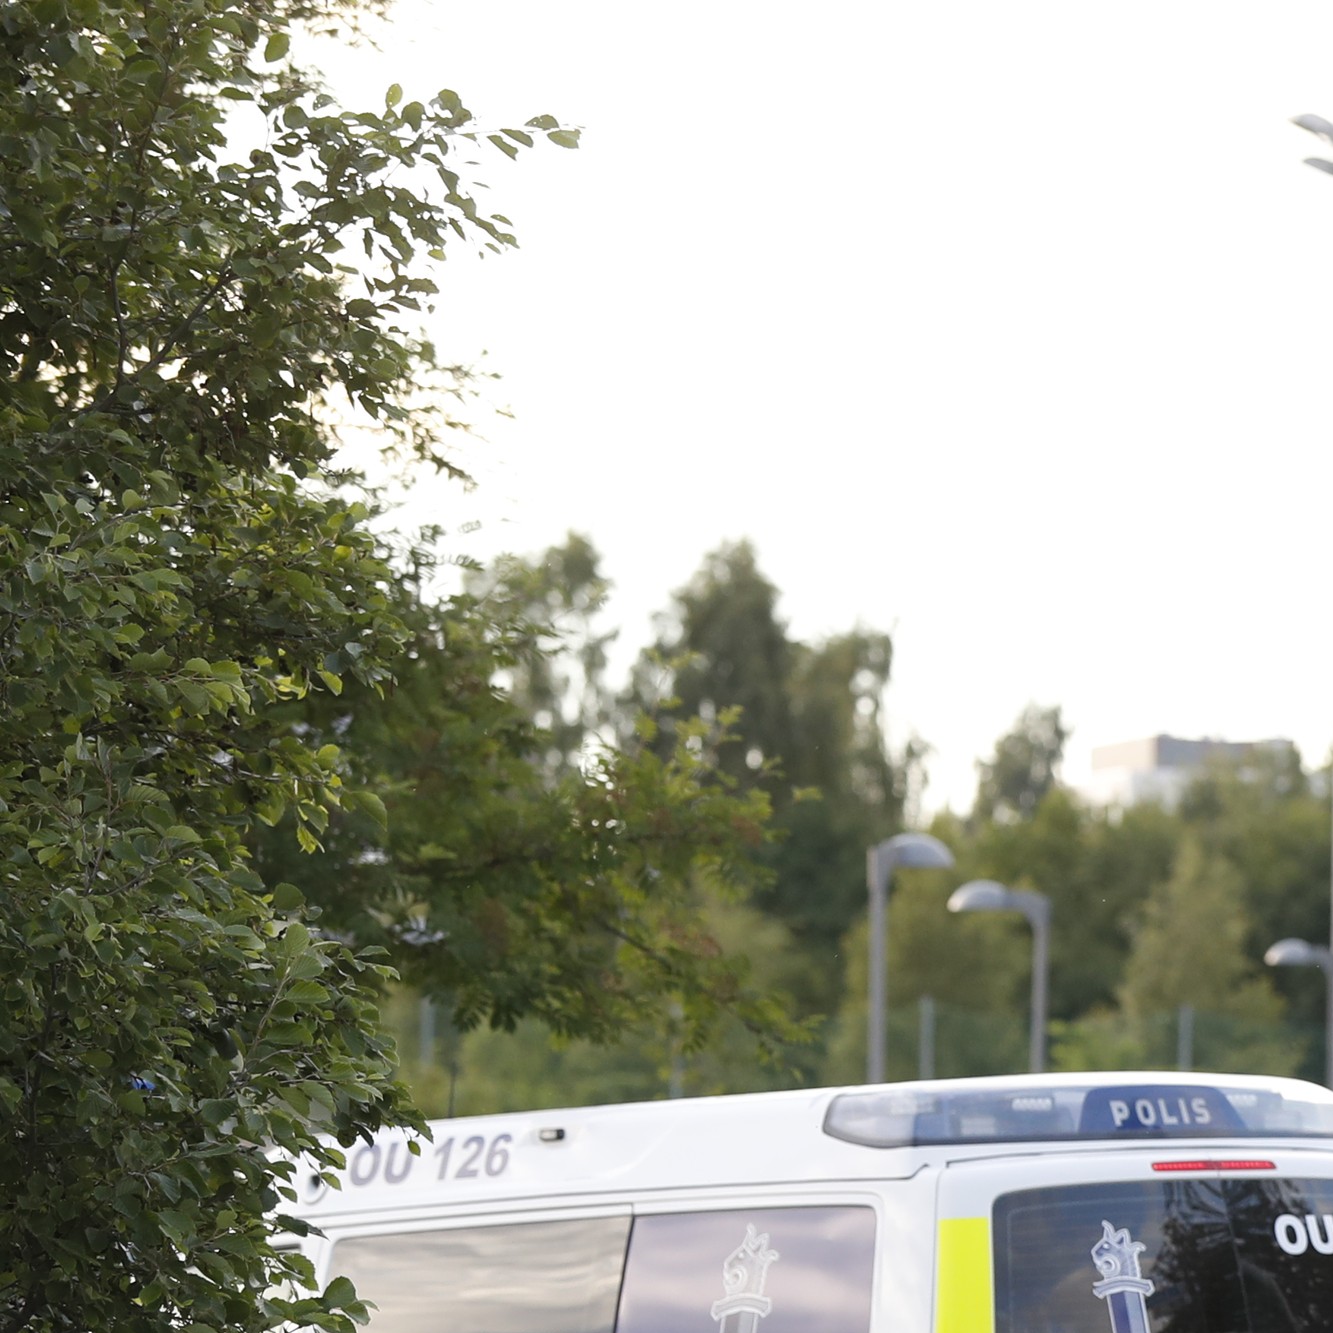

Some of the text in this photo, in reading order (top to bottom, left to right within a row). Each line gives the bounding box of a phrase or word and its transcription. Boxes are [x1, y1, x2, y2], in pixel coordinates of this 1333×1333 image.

[1109, 1097, 1212, 1127] POLIS
[350, 1133, 512, 1187] OU 126
